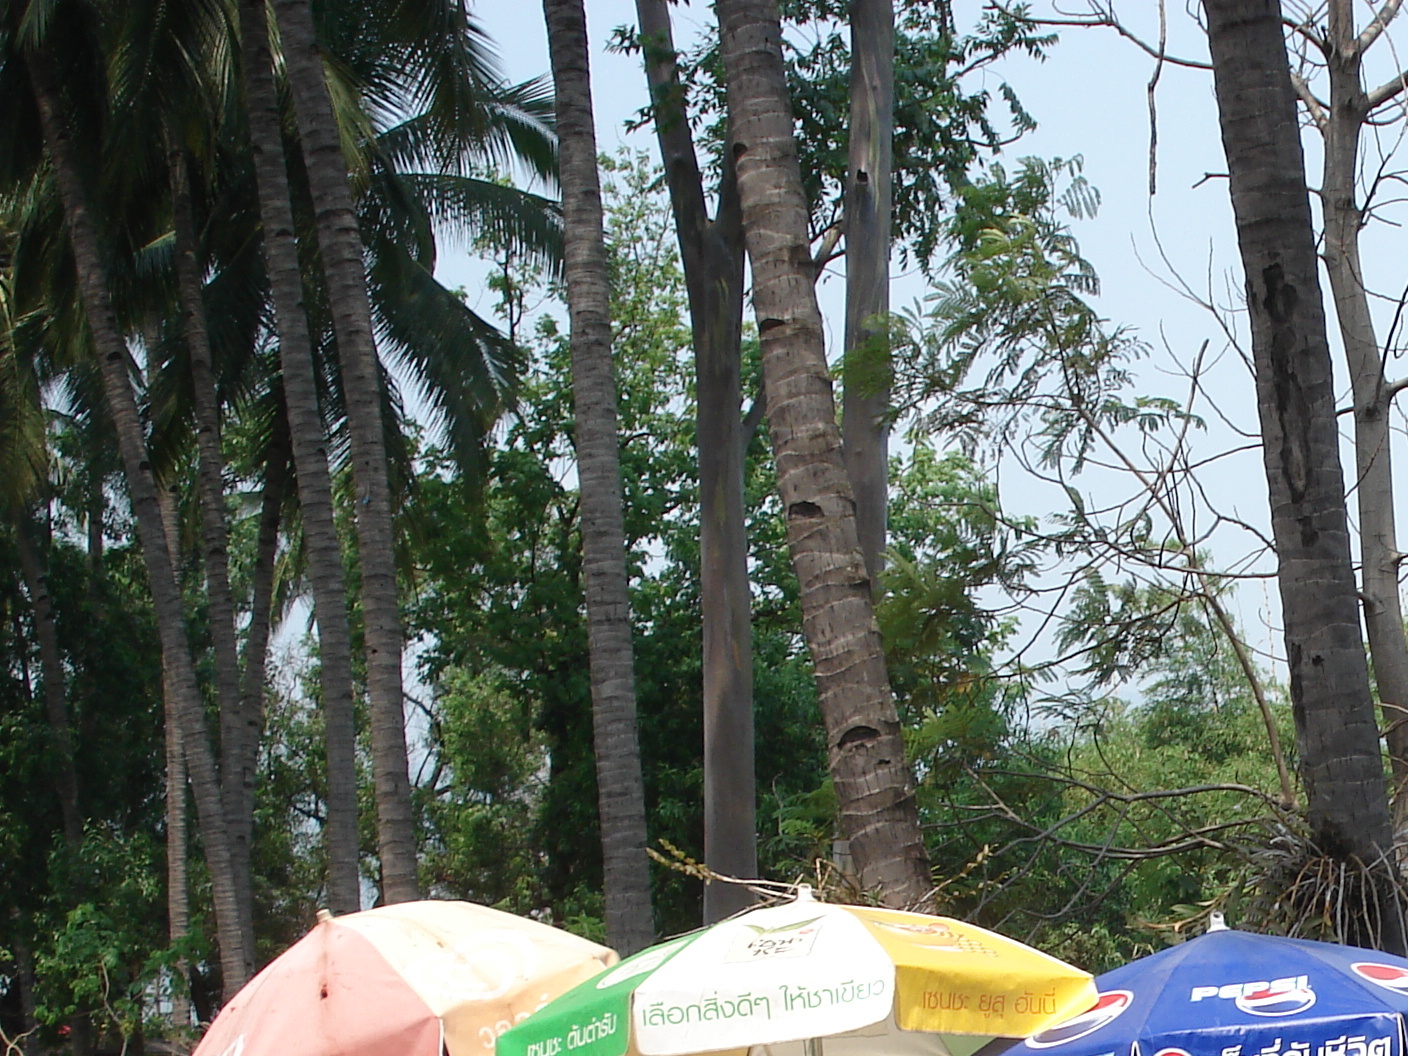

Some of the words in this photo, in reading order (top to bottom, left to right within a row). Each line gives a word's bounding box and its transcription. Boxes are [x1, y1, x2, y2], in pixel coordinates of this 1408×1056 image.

[642, 990, 771, 1027] เลือกสิ่งดีๆ
[779, 979, 885, 1012] ให้ชาเขียว
[1191, 975, 1310, 1002] PEPSI
